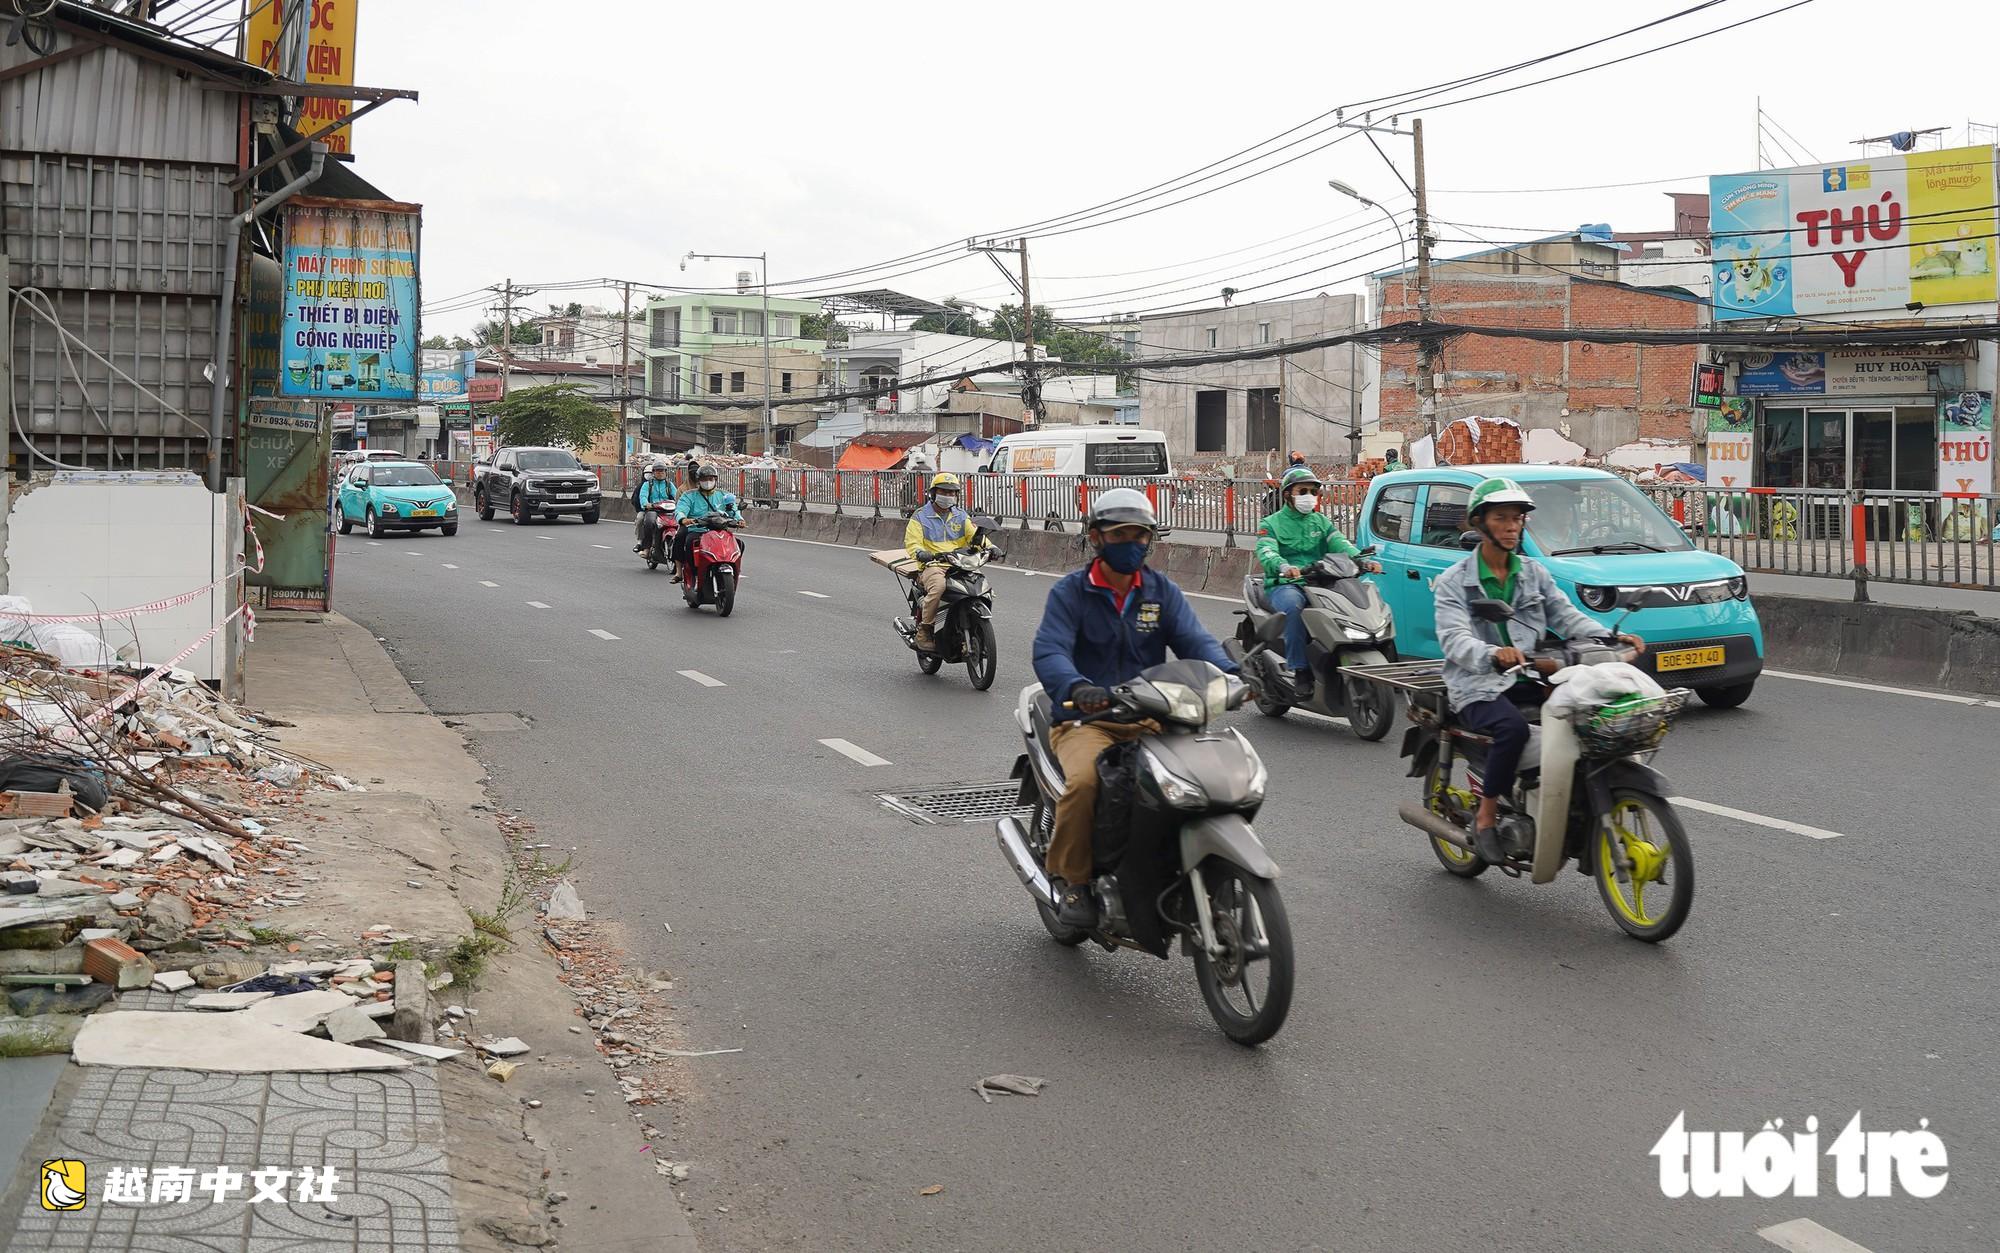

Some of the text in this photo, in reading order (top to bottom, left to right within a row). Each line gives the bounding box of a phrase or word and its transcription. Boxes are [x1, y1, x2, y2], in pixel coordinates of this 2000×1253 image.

[1796, 191, 1900, 247] THÚ
[297, 253, 327, 273] MÁY
[330, 258, 367, 275] PHUN
[1832, 250, 1867, 288] Y
[296, 279, 325, 300] PHỤ
[327, 278, 360, 301] KIỆN
[362, 280, 386, 300] HƠI
[298, 302, 340, 323] THIẾT
[344, 307, 359, 328] BỊ
[363, 306, 400, 329] ĐIỆN
[296, 328, 398, 354] CÔNG NGHIỆP
[1854, 362, 1885, 373] HUY
[1707, 437, 1751, 461] THÚ
[1939, 435, 1990, 462] THÚ
[266, 455, 287, 469] XE
[1955, 478, 1974, 493] Y
